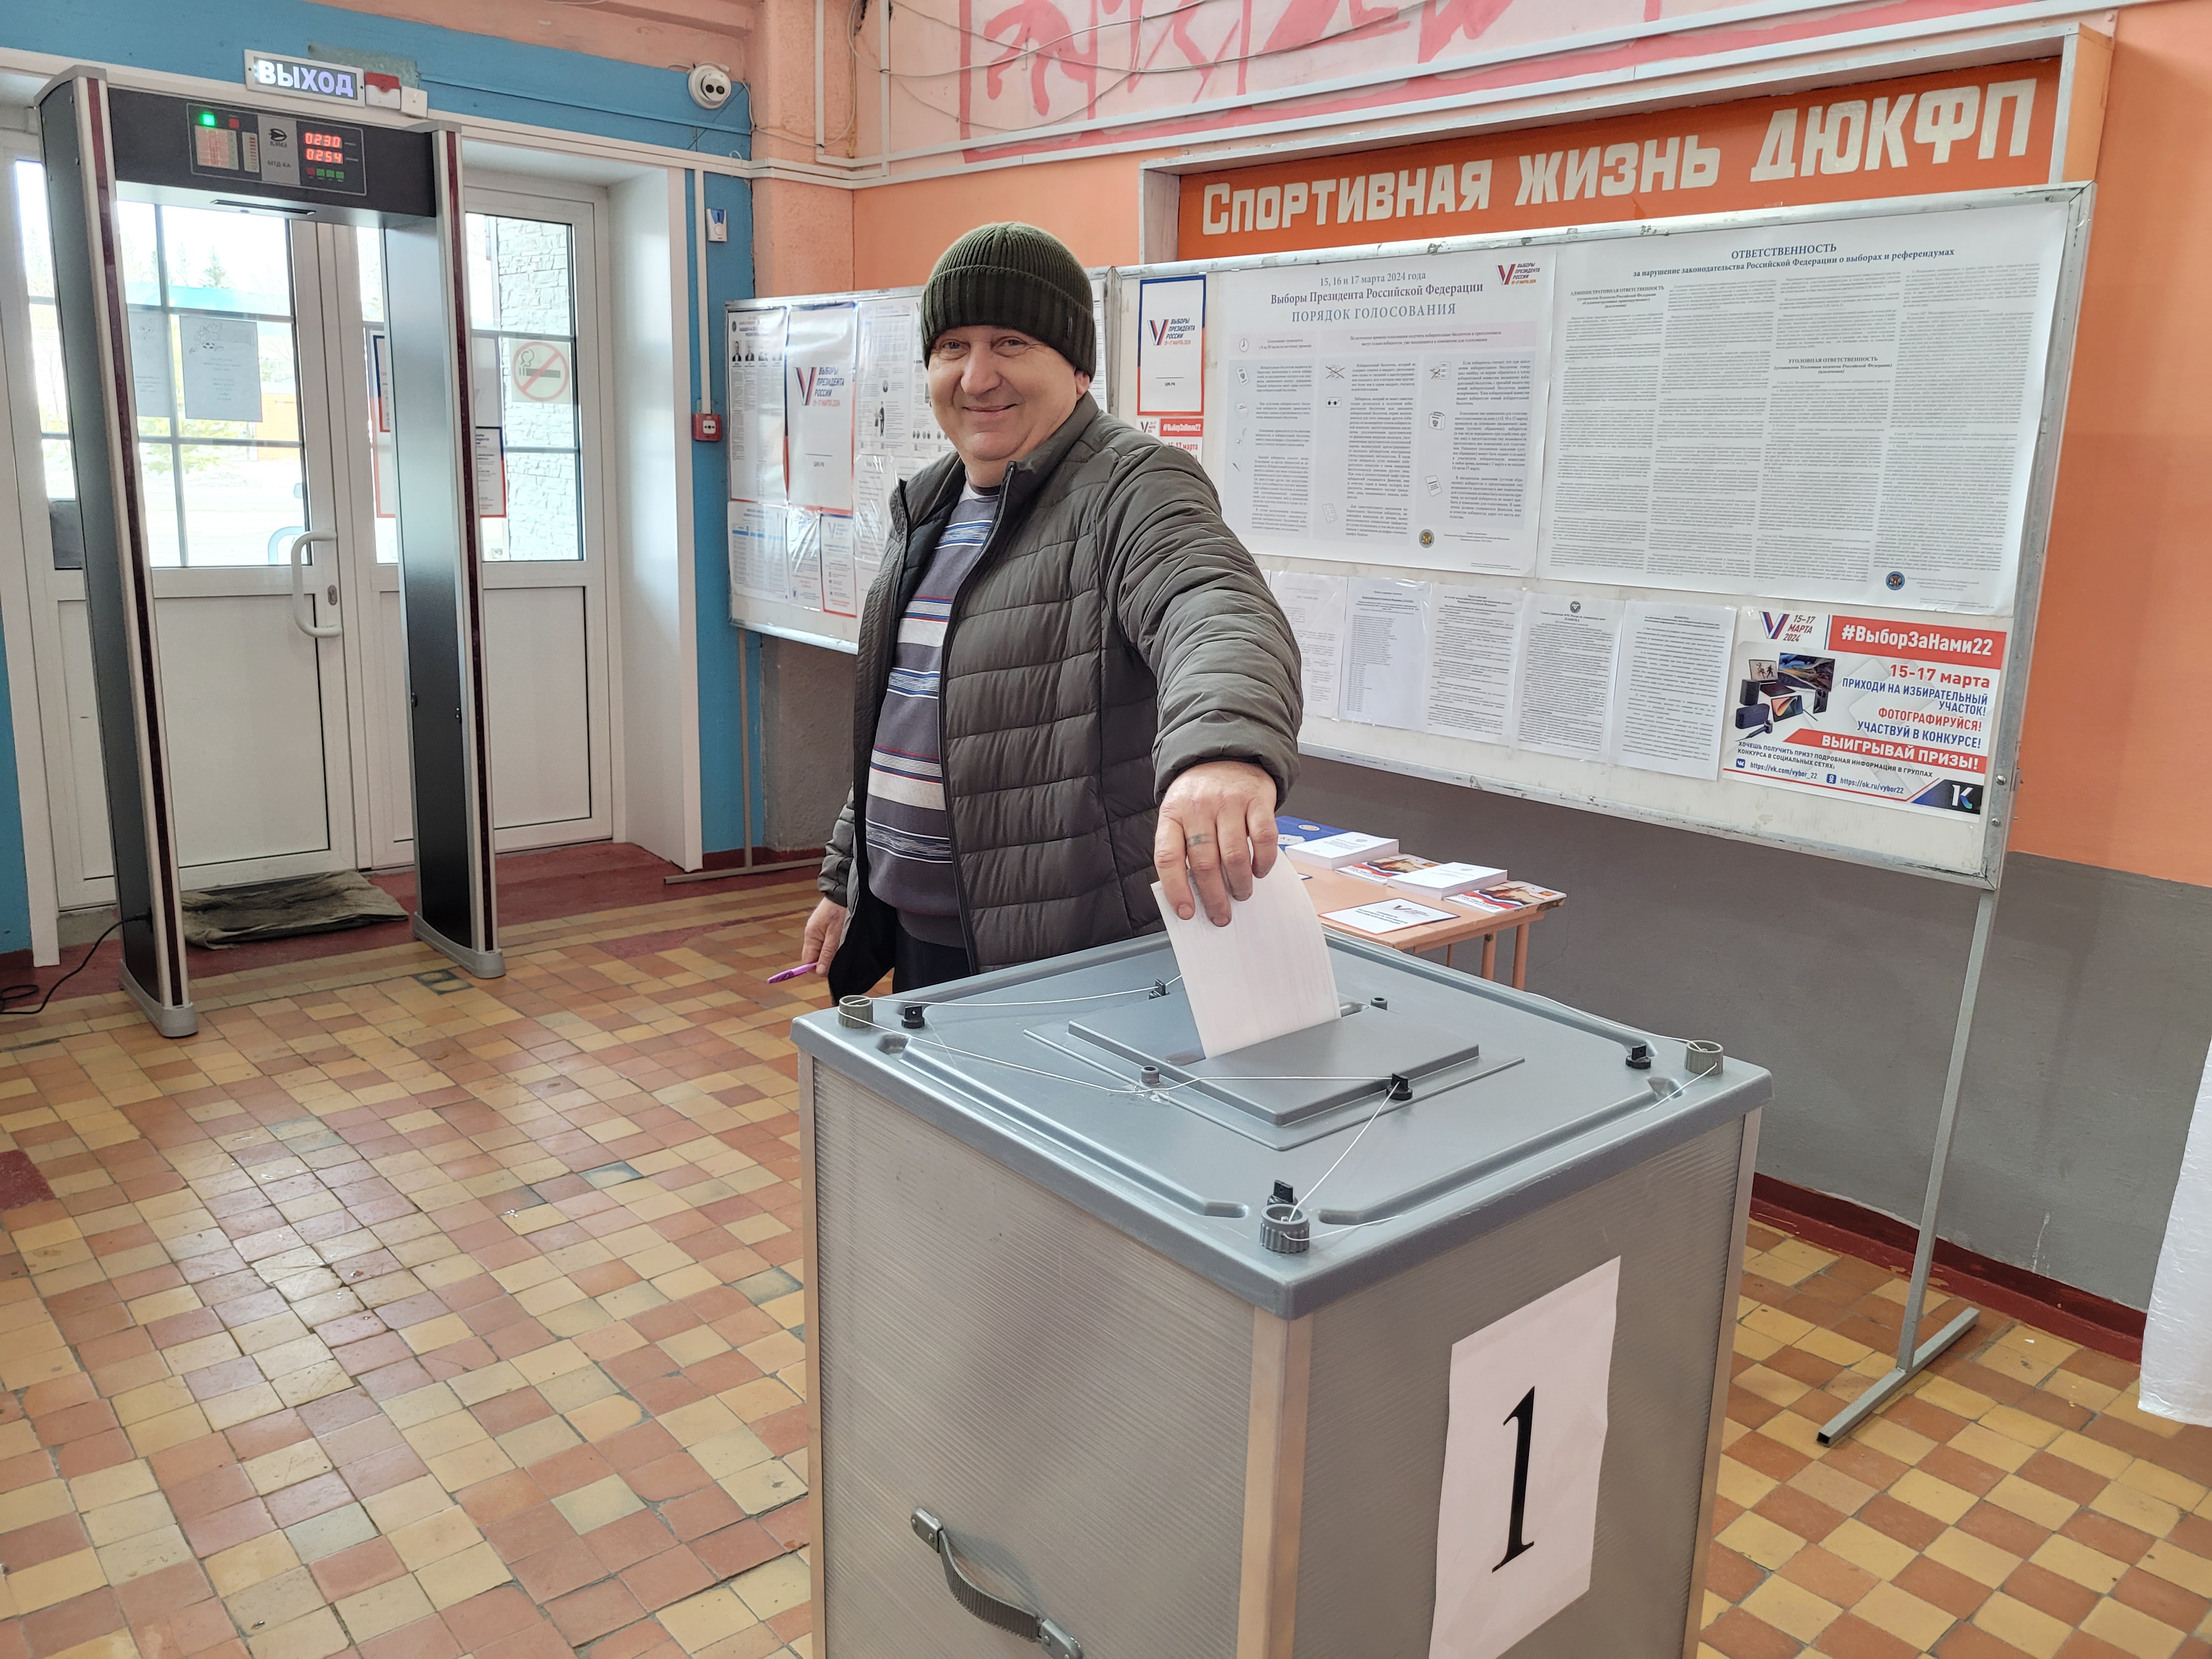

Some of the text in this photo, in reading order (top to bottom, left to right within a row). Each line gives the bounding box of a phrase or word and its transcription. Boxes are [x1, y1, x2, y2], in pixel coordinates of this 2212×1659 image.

[258, 60, 354, 98] ВЫХОД
[305, 132, 341, 148] 0230
[1514, 134, 1721, 206] ЖИЗНЬ
[1749, 78, 2038, 183] ДЮКФП
[306, 148, 343, 163] 0254
[1731, 243, 1837, 259] ОТВЕТСТВЕННОСТЬ
[1642, 268, 1680, 278] нарушение
[1681, 264, 1744, 274] законодательства
[1746, 259, 1791, 269] Российской
[1792, 257, 1837, 267] Федерации
[1846, 253, 1882, 263] выборах
[1891, 249, 1955, 261] референдумах
[1321, 278, 1331, 287] 15,
[1333, 277, 1341, 285] 16
[1351, 275, 1359, 284] 17
[1361, 275, 1385, 285] марта
[1387, 272, 1406, 281] 2024
[1408, 272, 1426, 281] года
[1271, 283, 1483, 306] Выборы Президента Российской Федерации
[1292, 303, 1456, 323] ПОРЯДОК ГОЛОСОВАНИЯ
[816, 378, 844, 387] ПРЕЗИДЕНТА
[819, 366, 839, 375] ВЫБОРЫ
[1783, 633, 1801, 642] 2024
[1787, 624, 1813, 634] МАРТА
[1841, 624, 1993, 656] #ВыборЗаНами22
[1890, 664, 1990, 689] 15-17 марта
[1842, 678, 1988, 706] ПРИХОДИ НА ИЗБИРАТЕЛЬНЫЙ
[1878, 707, 1982, 732] ФОТОГРАФИРУЙСЯ!
[1938, 701, 1986, 716] УЧАСТОК!
[1857, 720, 1981, 749] УЧАСТВУЙ В КОНКУРСЕ!
[1737, 748, 1767, 758] КОНКУРСА
[1773, 754, 1813, 766] СОЦИАЛЬНЫХ
[1738, 741, 1762, 749] ХОЧЕШЬ
[1763, 745, 1793, 755] ПОЛУЧИТЬ
[1814, 753, 1850, 764] ПОДРОБНАЯ
[1852, 759, 1896, 771] ИНФОРМАЦИЯ
[1903, 768, 1933, 777] ГРУППАХ
[1821, 734, 1979, 770] ВЫИГРЫВАЙ ПРИЗЫ!
[1750, 762, 1904, 794] https://vk.com/vybor_22 https://ok.ru/vybor22
[1492, 1385, 1535, 1573] 1
